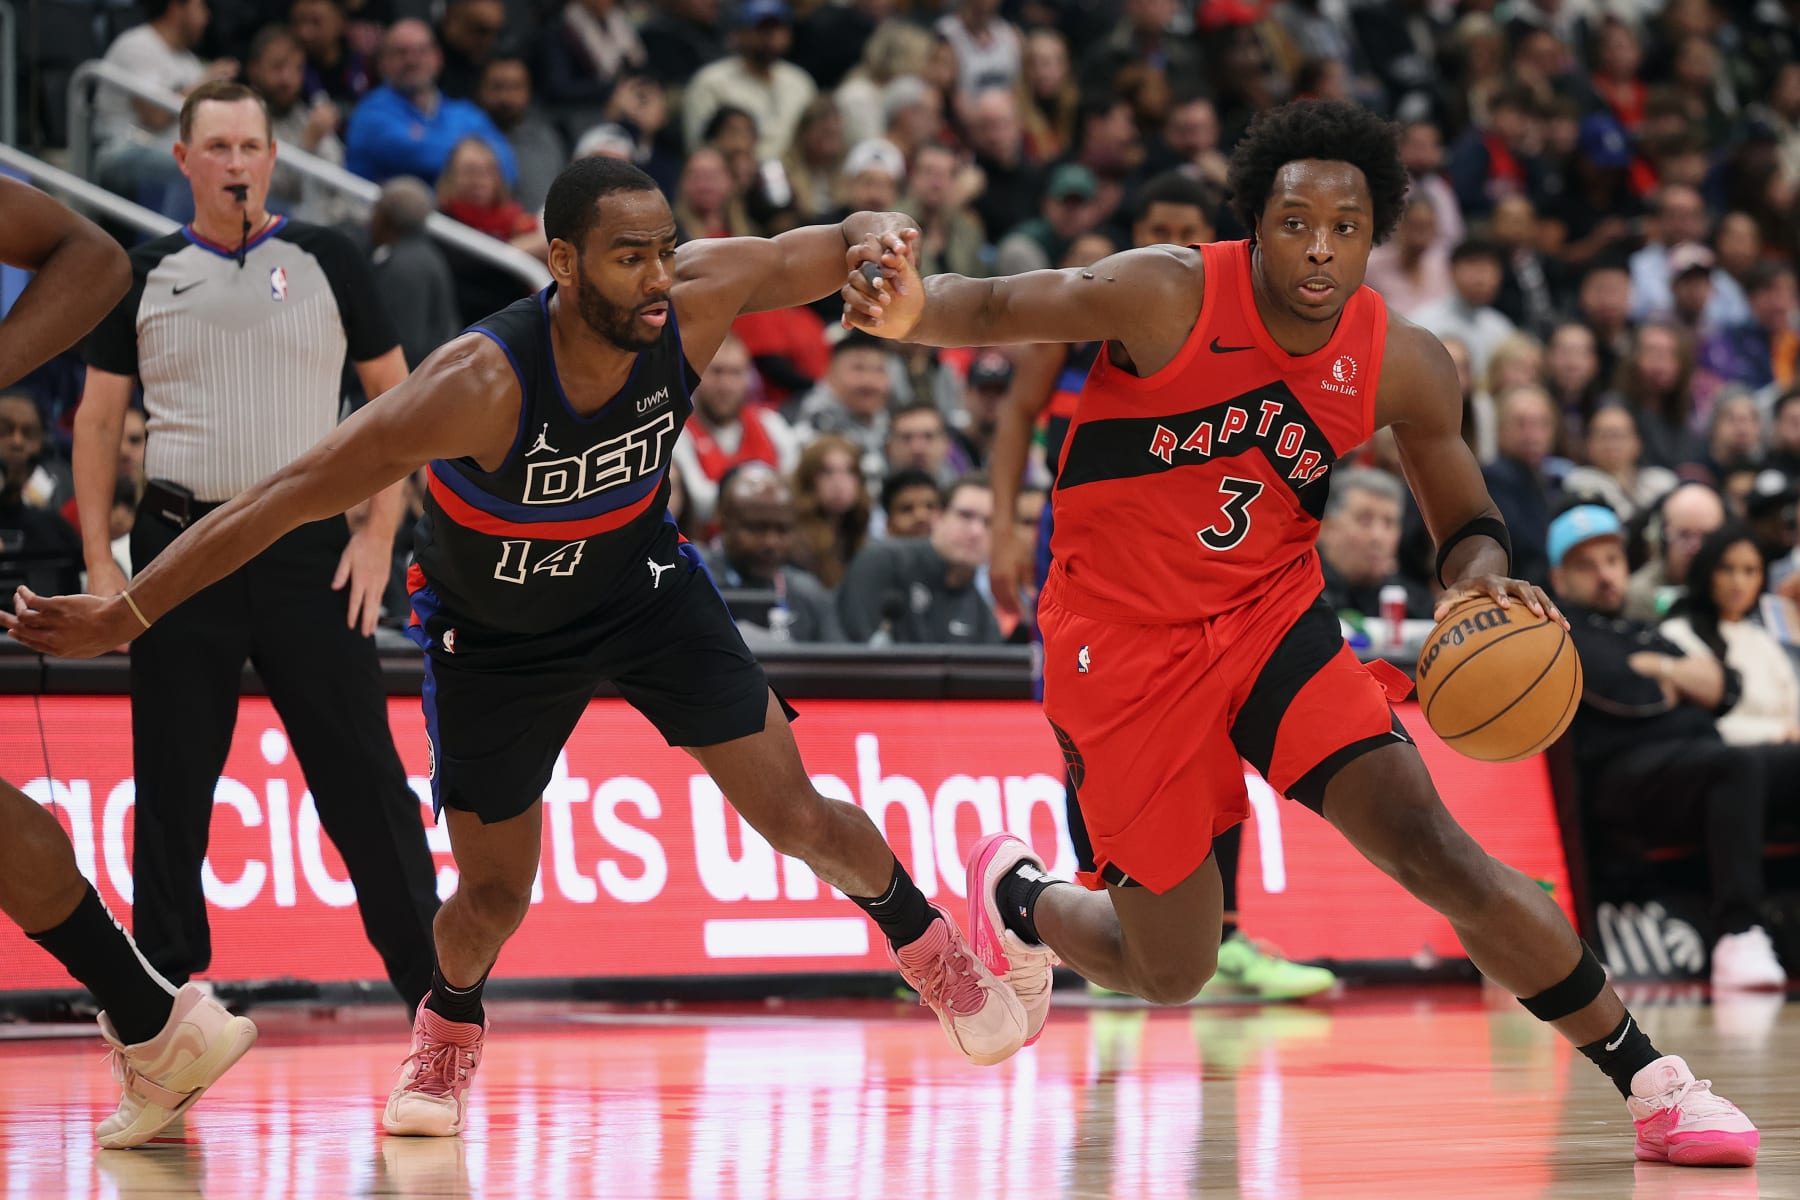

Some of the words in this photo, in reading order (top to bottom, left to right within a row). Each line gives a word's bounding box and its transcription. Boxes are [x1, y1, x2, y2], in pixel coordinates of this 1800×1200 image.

[636, 385, 669, 413] UWM
[1320, 379, 1339, 392] Sun
[1340, 384, 1358, 397] Life
[522, 411, 674, 504] DET
[1197, 476, 1264, 551] 3
[494, 540, 587, 584] 14
[1419, 607, 1513, 680] Wilson
